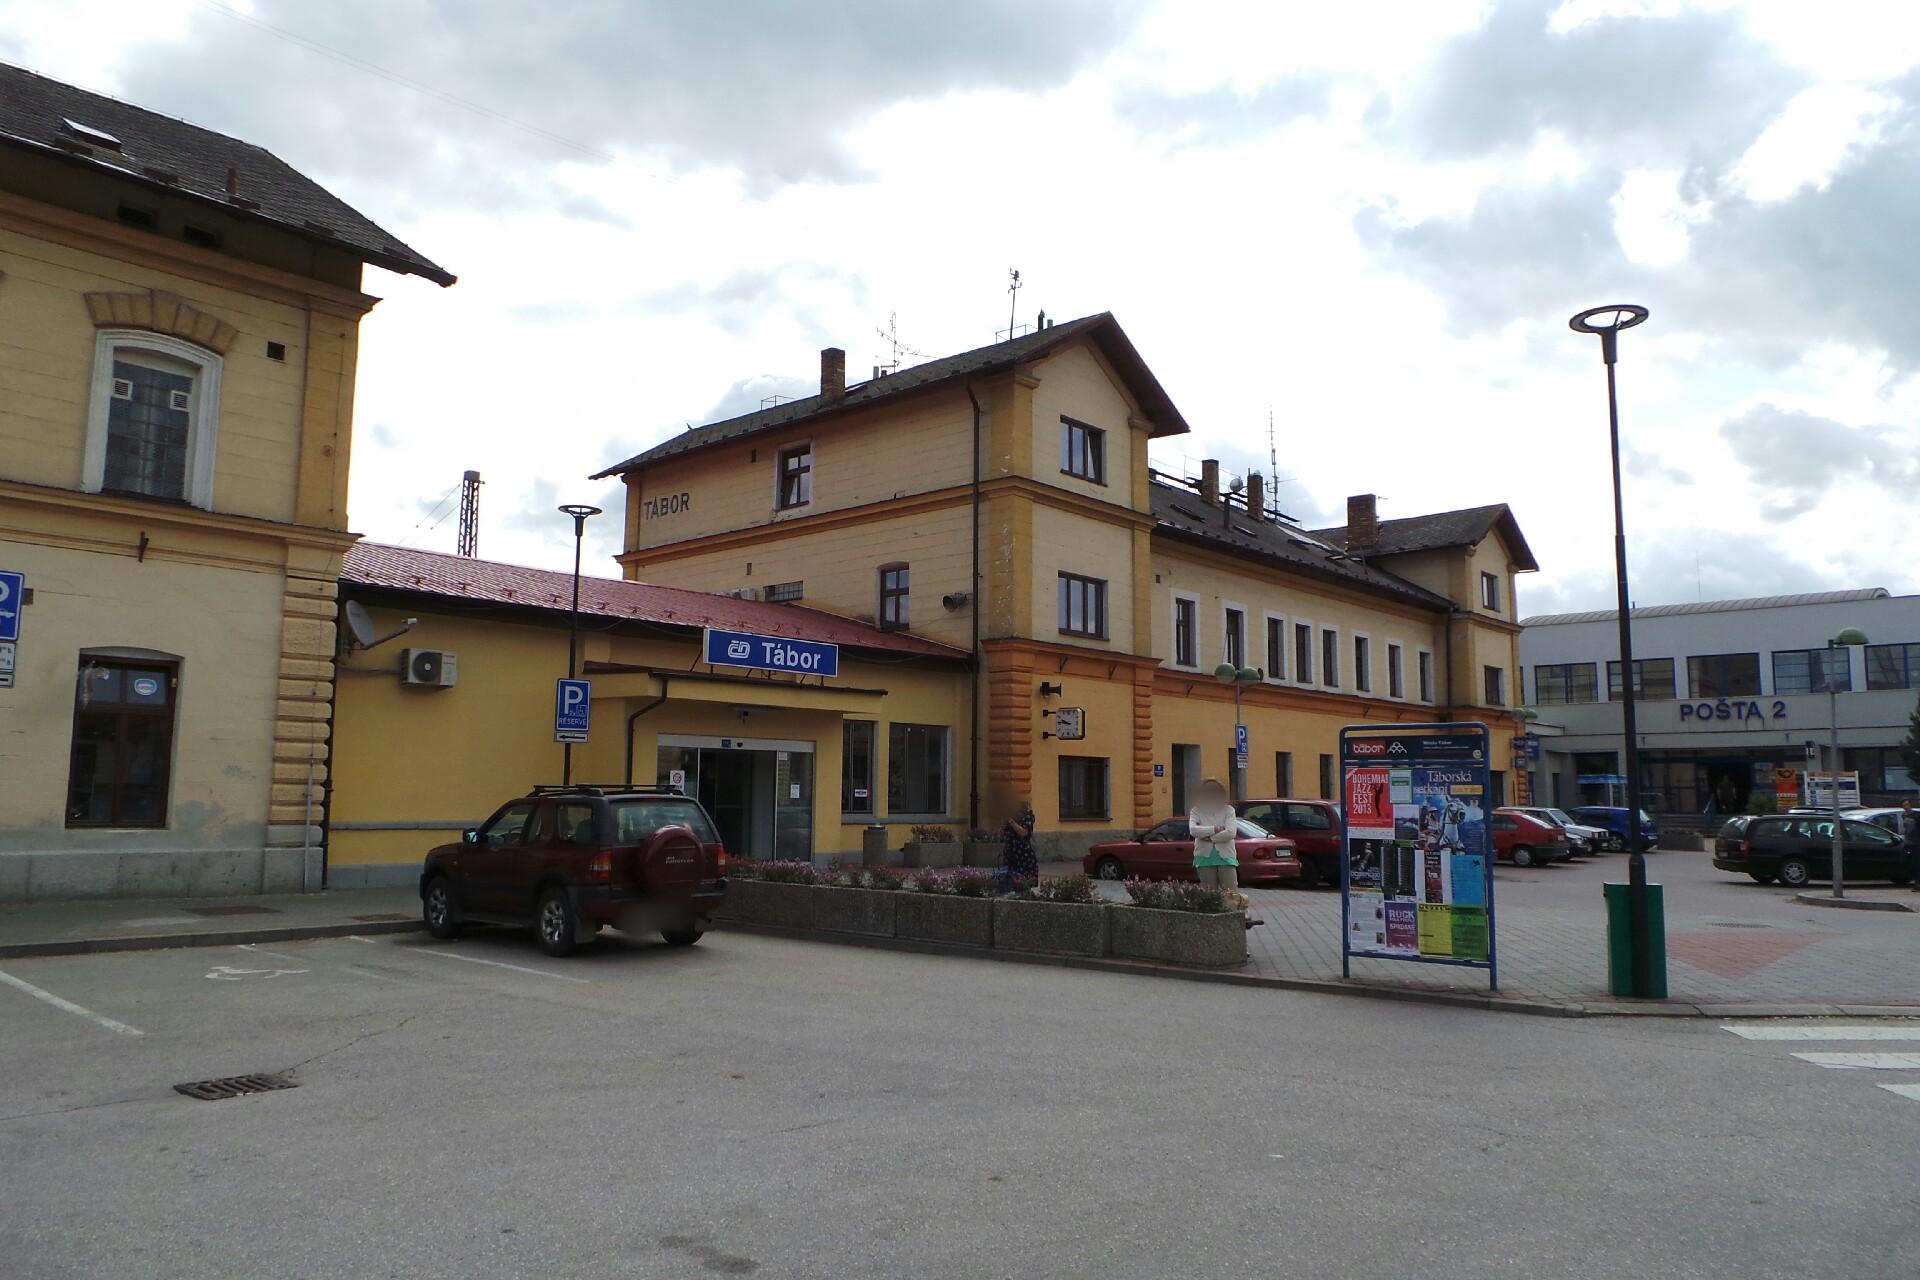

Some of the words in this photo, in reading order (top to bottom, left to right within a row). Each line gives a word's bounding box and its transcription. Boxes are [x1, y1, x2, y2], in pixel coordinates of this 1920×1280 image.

[761, 641, 821, 669] Tábor
[564, 686, 584, 715] P
[1679, 698, 1763, 721] POŠTA
[1772, 700, 1787, 719] 2
[1238, 727, 1246, 745] P
[1426, 770, 1473, 783] Táborská
[1352, 783, 1372, 793] JAZZ
[1353, 793, 1373, 804] FEST
[1353, 804, 1372, 814] 2013
